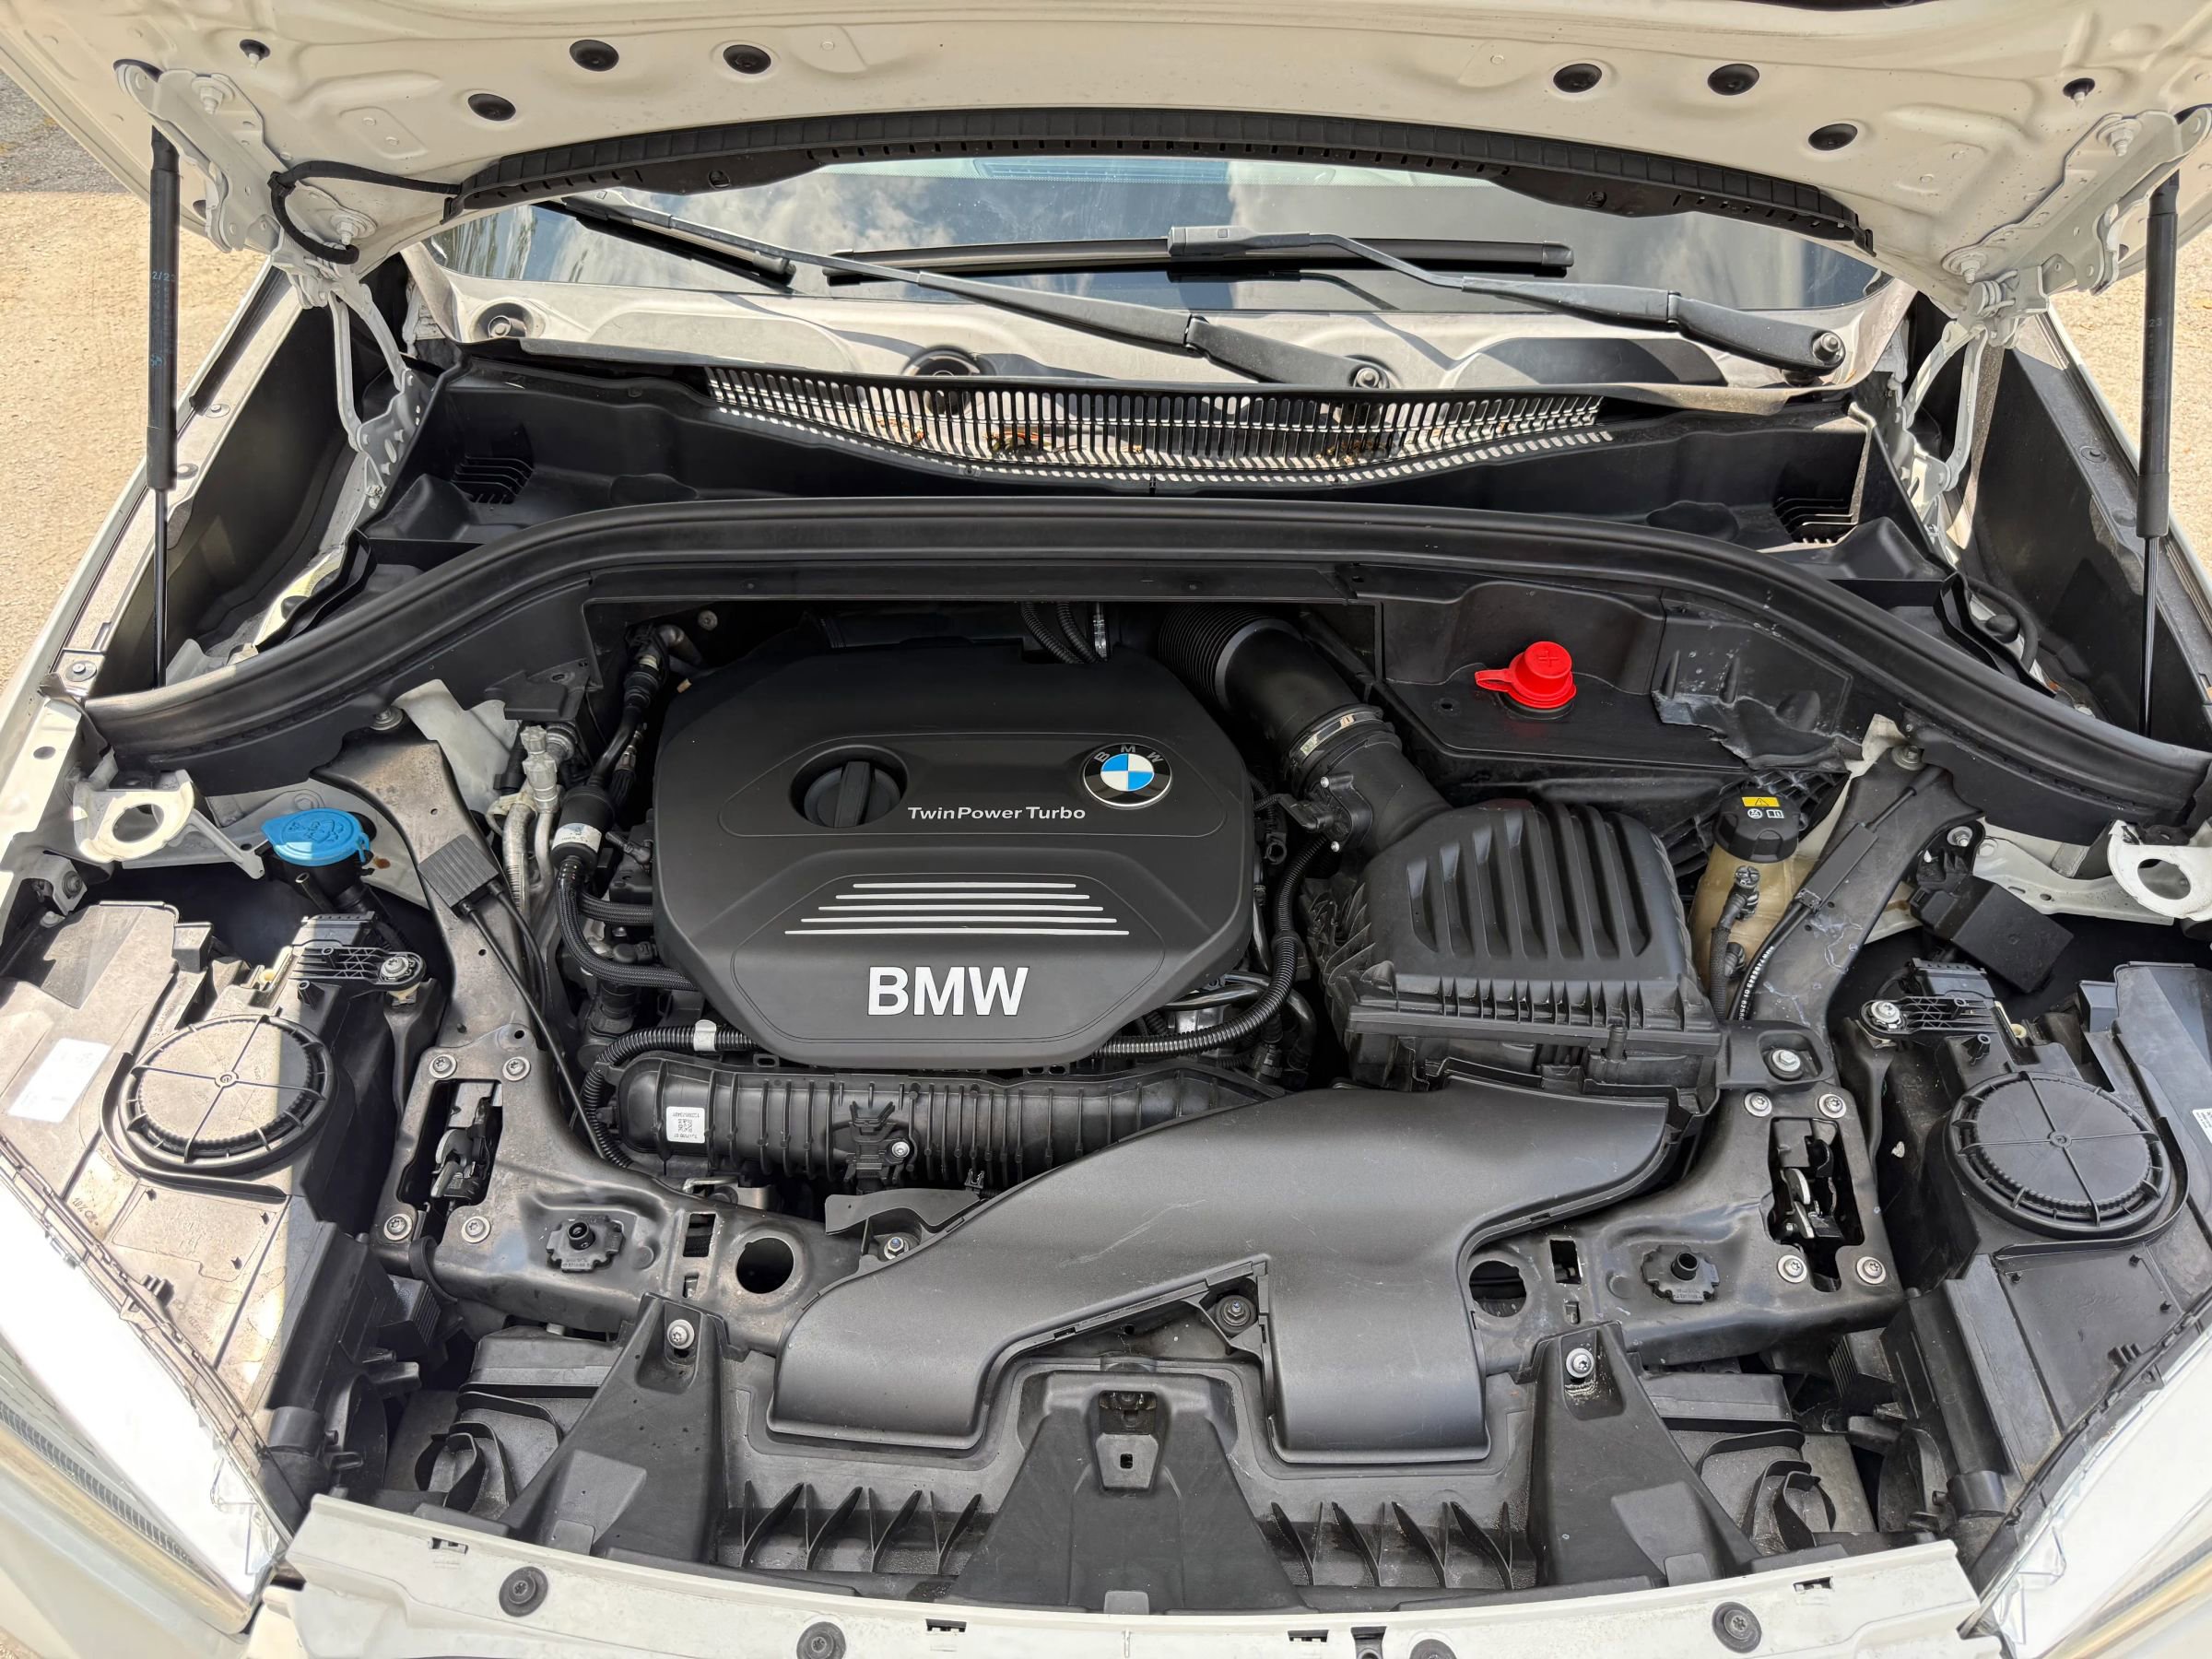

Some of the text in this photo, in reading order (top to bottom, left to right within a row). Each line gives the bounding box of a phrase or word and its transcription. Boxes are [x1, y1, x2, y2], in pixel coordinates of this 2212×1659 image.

[1094, 745, 1164, 763] BMW
[908, 806, 1086, 819] TwinPower Turbo
[867, 966, 1030, 1017] BMW
